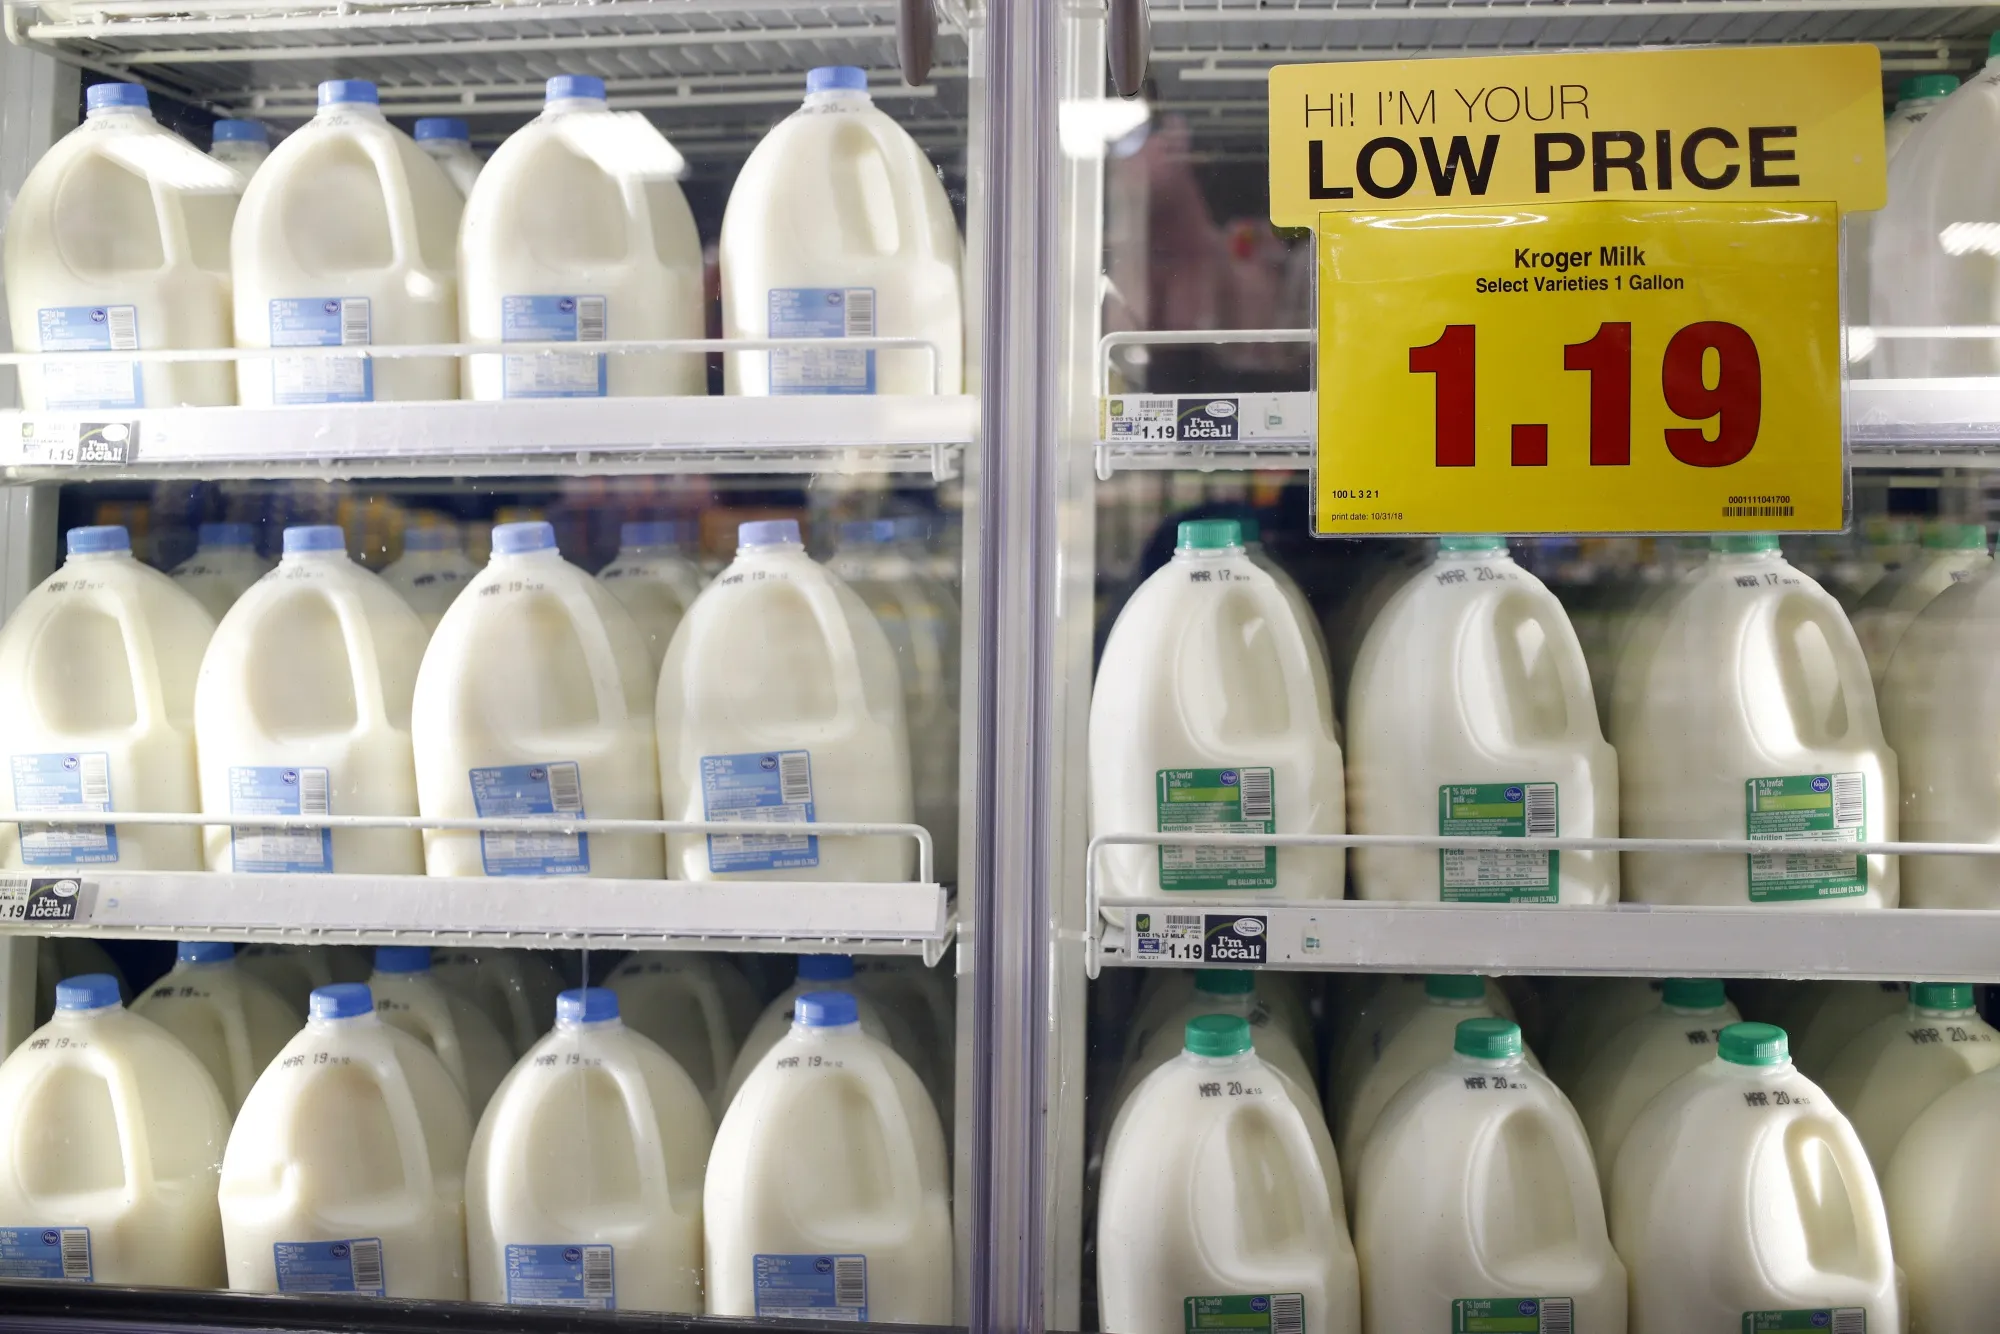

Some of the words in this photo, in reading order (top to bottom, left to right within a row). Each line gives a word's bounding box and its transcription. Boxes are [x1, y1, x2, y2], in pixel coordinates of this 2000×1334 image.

[1304, 92, 1355, 128] Hi!
[1455, 84, 1589, 123] YOUR
[1309, 134, 1501, 200] LOW
[1534, 125, 1801, 193] PRICE
[1514, 248, 1593, 272] Kroger
[1599, 246, 1646, 267] Milk
[1476, 277, 1530, 293] Select
[1534, 276, 1609, 292] Varieties
[1615, 276, 1622, 291] 1
[1629, 274, 1685, 291] Gallon
[272, 300, 282, 331] SKIM
[771, 290, 781, 325] SKIM
[40, 310, 53, 341] SKIM
[1409, 321, 1762, 468] 1.19
[1142, 425, 1175, 440] 1.19
[1183, 425, 1231, 438] local!
[48, 448, 74, 461] 1.19
[81, 447, 122, 461] local!
[1332, 490, 1348, 499] 100
[1350, 490, 1356, 499] L
[1358, 490, 1364, 499] 3
[1366, 490, 1372, 499] 2
[1374, 490, 1379, 499] 1
[1331, 513, 1348, 522] print
[1350, 512, 1369, 520] date:
[1371, 512, 1403, 520] 10/31/18
[722, 573, 744, 587] MAR
[752, 571, 766, 581] 19
[1190, 570, 1212, 583] MAR
[1218, 569, 1230, 581] 17
[1436, 569, 1469, 586] MAR
[1474, 566, 1495, 582] 20
[1733, 574, 1760, 588] MAR
[1764, 573, 1778, 586] 17
[47, 580, 68, 593] MAR
[73, 579, 87, 590] 19
[479, 584, 501, 596] MAR
[509, 581, 523, 592] 19
[13, 756, 24, 788] SKIM
[705, 758, 715, 791] SKIM
[232, 768, 242, 799] SKIM
[474, 770, 488, 802] SKIM
[30, 904, 71, 918] local!
[1217, 935, 1243, 948] I'm
[1168, 943, 1203, 959] 1.19
[1210, 944, 1261, 959] local!
[1906, 1027, 1944, 1045] MAR
[1947, 1026, 1969, 1042] 20
[28, 1038, 50, 1051] MAR
[54, 1037, 70, 1048] 19
[282, 1055, 305, 1070] MAR
[313, 1052, 328, 1065] 19
[534, 1054, 558, 1067] MAR
[566, 1053, 580, 1065] 19
[777, 1056, 800, 1070] MAR
[808, 1056, 822, 1067] 19
[1198, 1081, 1222, 1097] MAR
[1227, 1081, 1243, 1096] 20
[1463, 1076, 1488, 1090] MAR
[1492, 1076, 1508, 1089] 20
[1743, 1091, 1770, 1107] MAR
[1773, 1091, 1790, 1106] 20
[279, 1243, 290, 1274] SKIM
[509, 1247, 520, 1278] SKIM
[758, 1257, 769, 1288] SKIM
